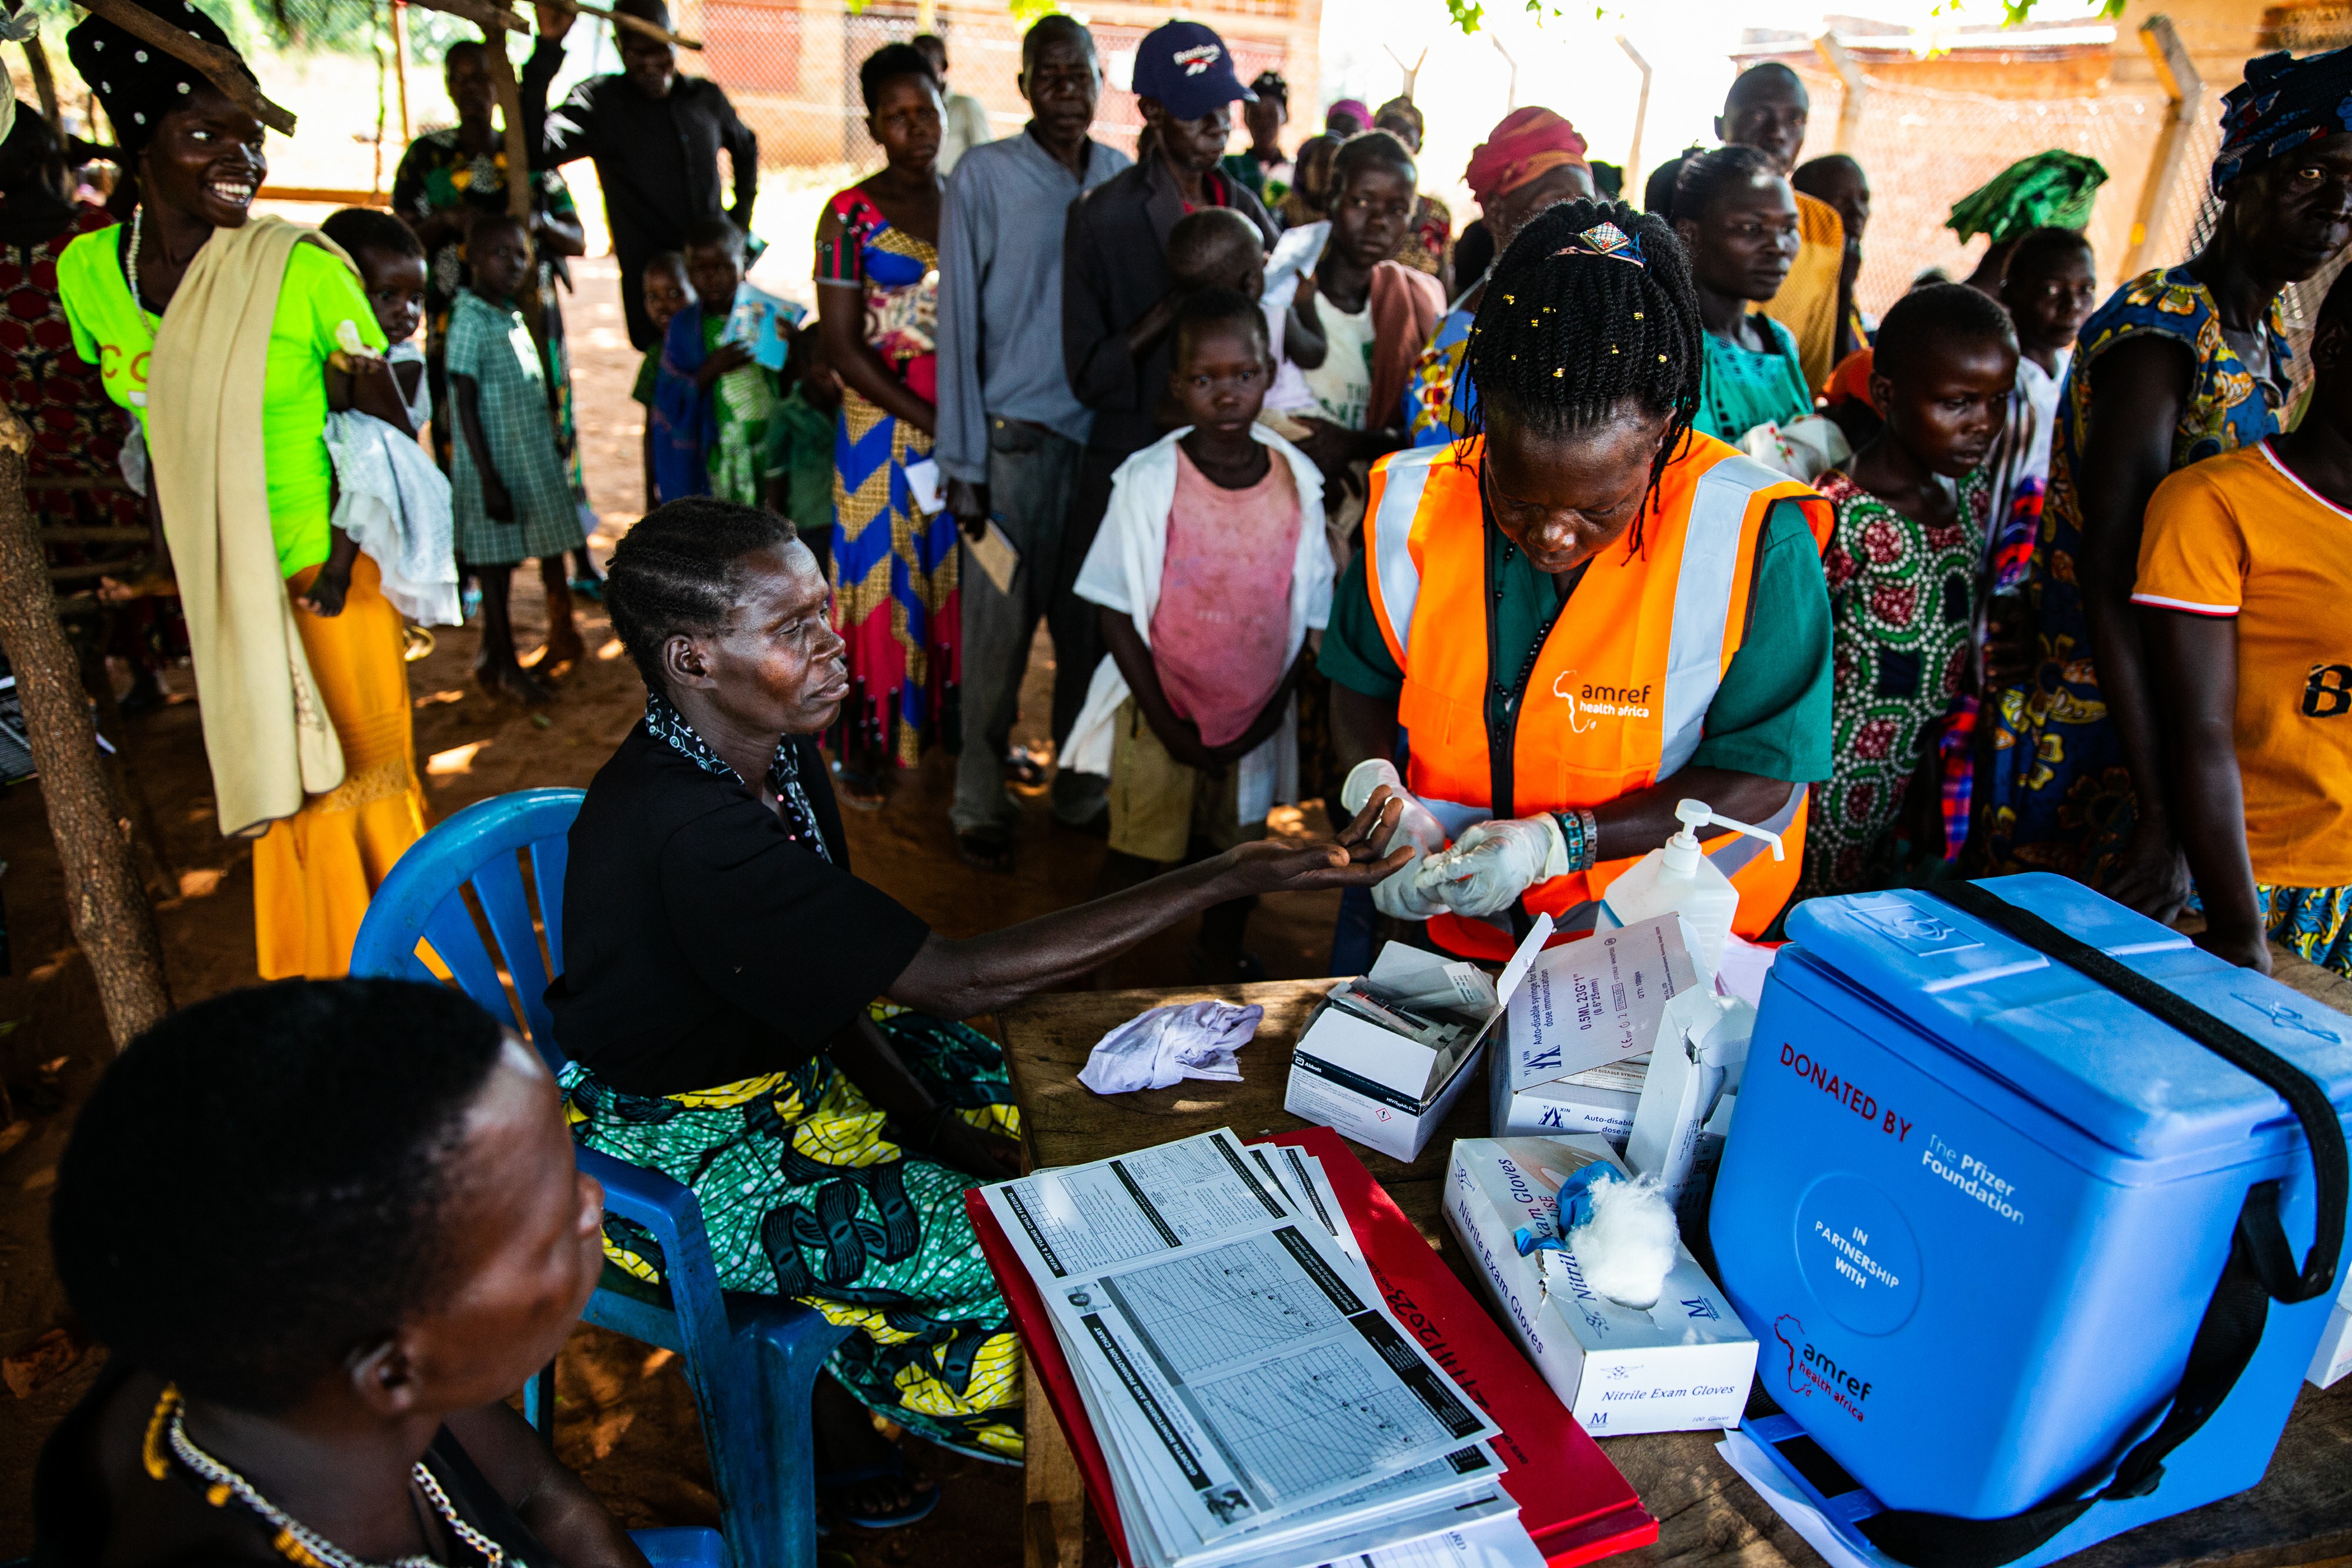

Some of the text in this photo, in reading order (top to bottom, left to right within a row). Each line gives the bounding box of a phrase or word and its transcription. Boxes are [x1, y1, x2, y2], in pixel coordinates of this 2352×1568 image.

[1582, 684, 1652, 703] amref
[1579, 700, 1649, 718] health africa
[1527, 959, 1542, 1045] Auto-disable syringe for fix
[1541, 968, 1553, 1027] dose immunization
[1616, 991, 1624, 1009] STERILE
[1578, 1001, 1592, 1030] 0.5ML
[1304, 1061, 1322, 1073] Abbott
[1780, 1043, 1913, 1142] DONATED BY
[1385, 1096, 1409, 1111] HIV/Syphilis
[1584, 1114, 1634, 1127] Auto-disable
[1929, 1134, 2016, 1197] The Pfizer
[1498, 1159, 1534, 1203] Gloves
[1922, 1151, 2024, 1225] Foundation
[1005, 1192, 1025, 1213] FEEDING
[1019, 1213, 1034, 1229] CHILD
[1311, 1195, 1323, 1212] REFERRAL
[1319, 1211, 1334, 1235] INFORMATION
[1528, 1208, 1553, 1239] xam
[1028, 1229, 1046, 1246] YOUNG
[1284, 1236, 1297, 1246] record
[1852, 1226, 1868, 1246] IN
[1044, 1252, 1061, 1270] INFANT
[1293, 1246, 1309, 1259] properly
[1307, 1254, 1321, 1265] mother
[1815, 1221, 1899, 1289] PARTNERSHIP
[1311, 1266, 1322, 1275] each
[1318, 1275, 1332, 1286] during
[1458, 1199, 1544, 1355] Nitrile Exam Gloves
[1558, 1252, 1598, 1302] Nitril
[1835, 1256, 1866, 1289] WITH
[1325, 1274, 1341, 1288] interpret
[1327, 1285, 1338, 1293] child
[1379, 1276, 1394, 1292] DATE
[1339, 1299, 1354, 1310] Weigh
[1680, 1299, 1711, 1319] M
[1704, 1297, 1722, 1320] Medium
[1093, 1326, 1112, 1348] CHART
[1107, 1348, 1137, 1386] PROMOTION
[1803, 1343, 1873, 1402] amref
[1132, 1385, 1147, 1400] AND
[1601, 1385, 1735, 1401] Nitrile Exam Gloves
[1799, 1359, 1865, 1422] health africa
[1142, 1399, 1177, 1444] MONITORING
[1591, 1412, 1608, 1424] M
[1172, 1442, 1199, 1476] GROWTH
[1449, 1529, 1467, 1552] RD
